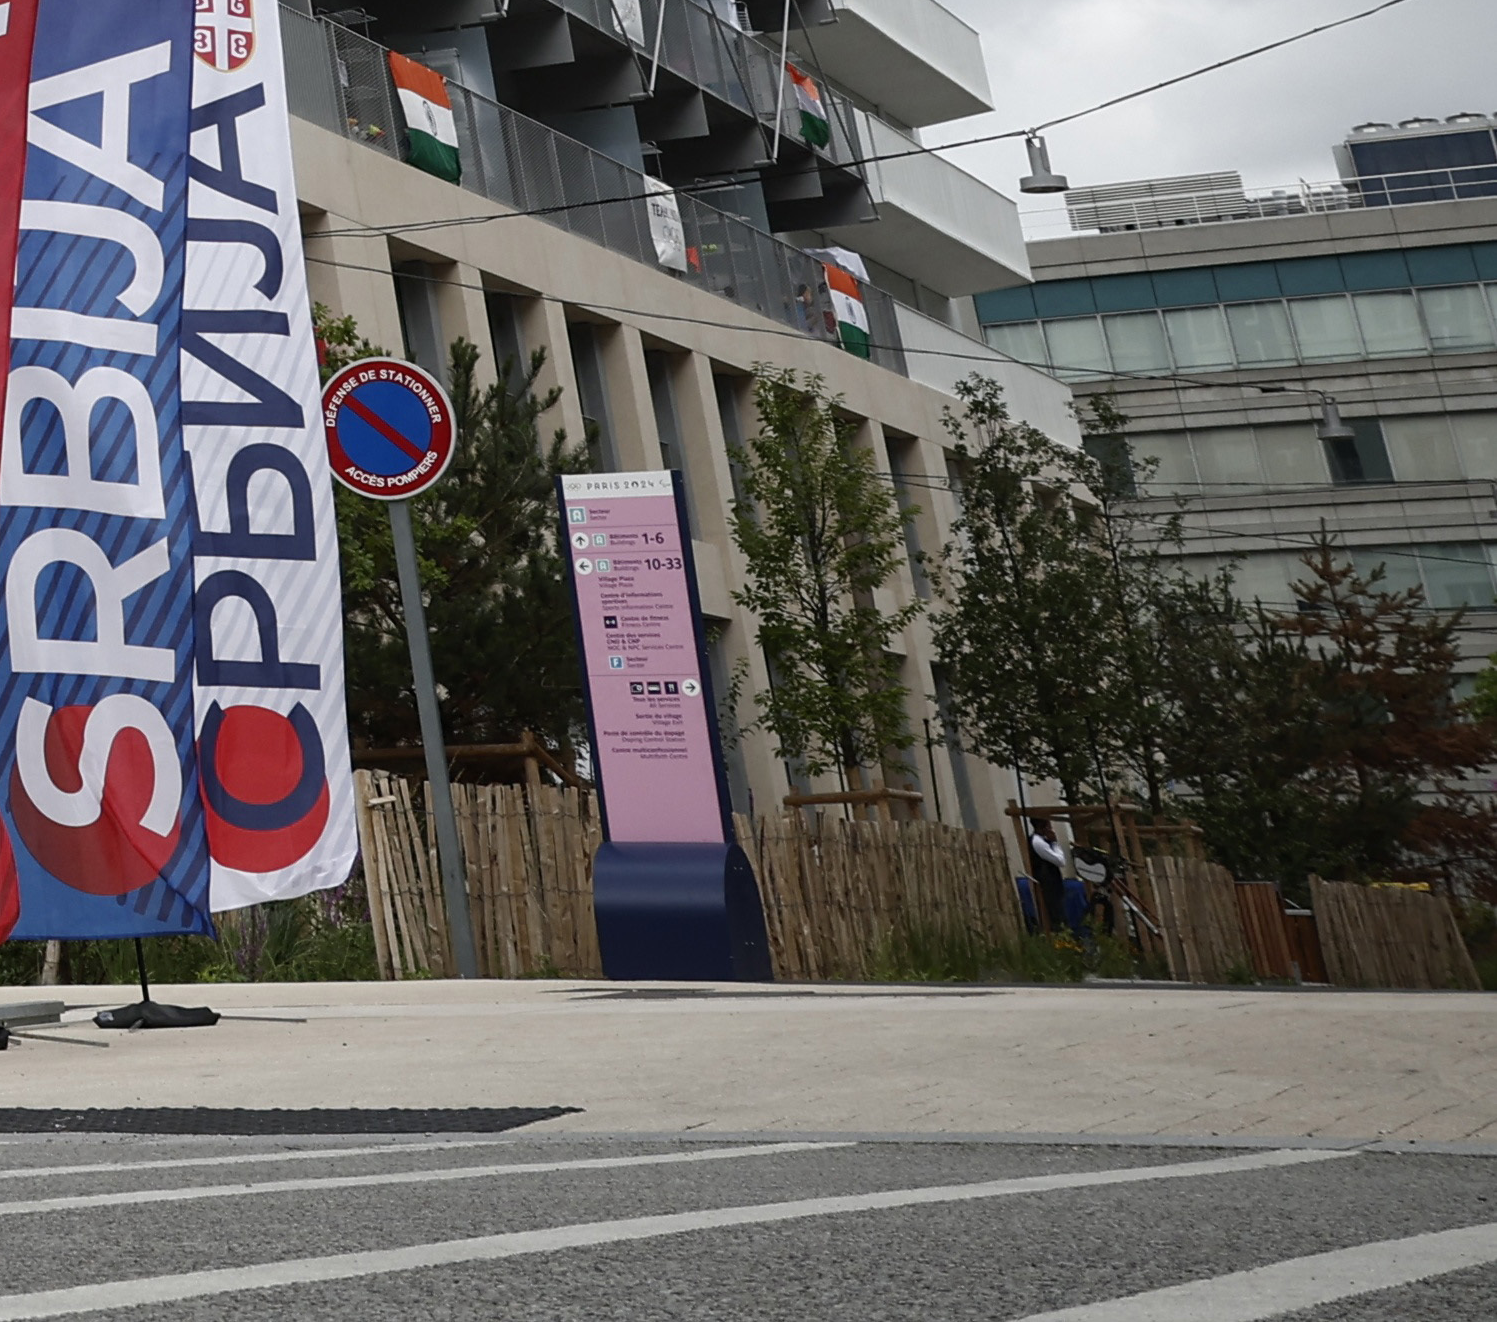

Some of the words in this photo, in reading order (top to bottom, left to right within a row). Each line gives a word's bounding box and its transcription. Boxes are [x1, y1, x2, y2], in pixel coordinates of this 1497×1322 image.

[325, 376, 360, 428] DÉFENSE
[358, 369, 377, 383] DE
[379, 368, 442, 424] STATIONNER
[0, 40, 182, 838] SRBIJA
[181, 82, 327, 831] СРБИЈА
[344, 465, 386, 488] ACCÈS
[387, 450, 438, 488] POMPIERS
[586, 481, 620, 490] PARIS
[623, 480, 654, 489] 2024
[642, 532, 665, 545] 1-6
[644, 557, 682, 571] 10-33
